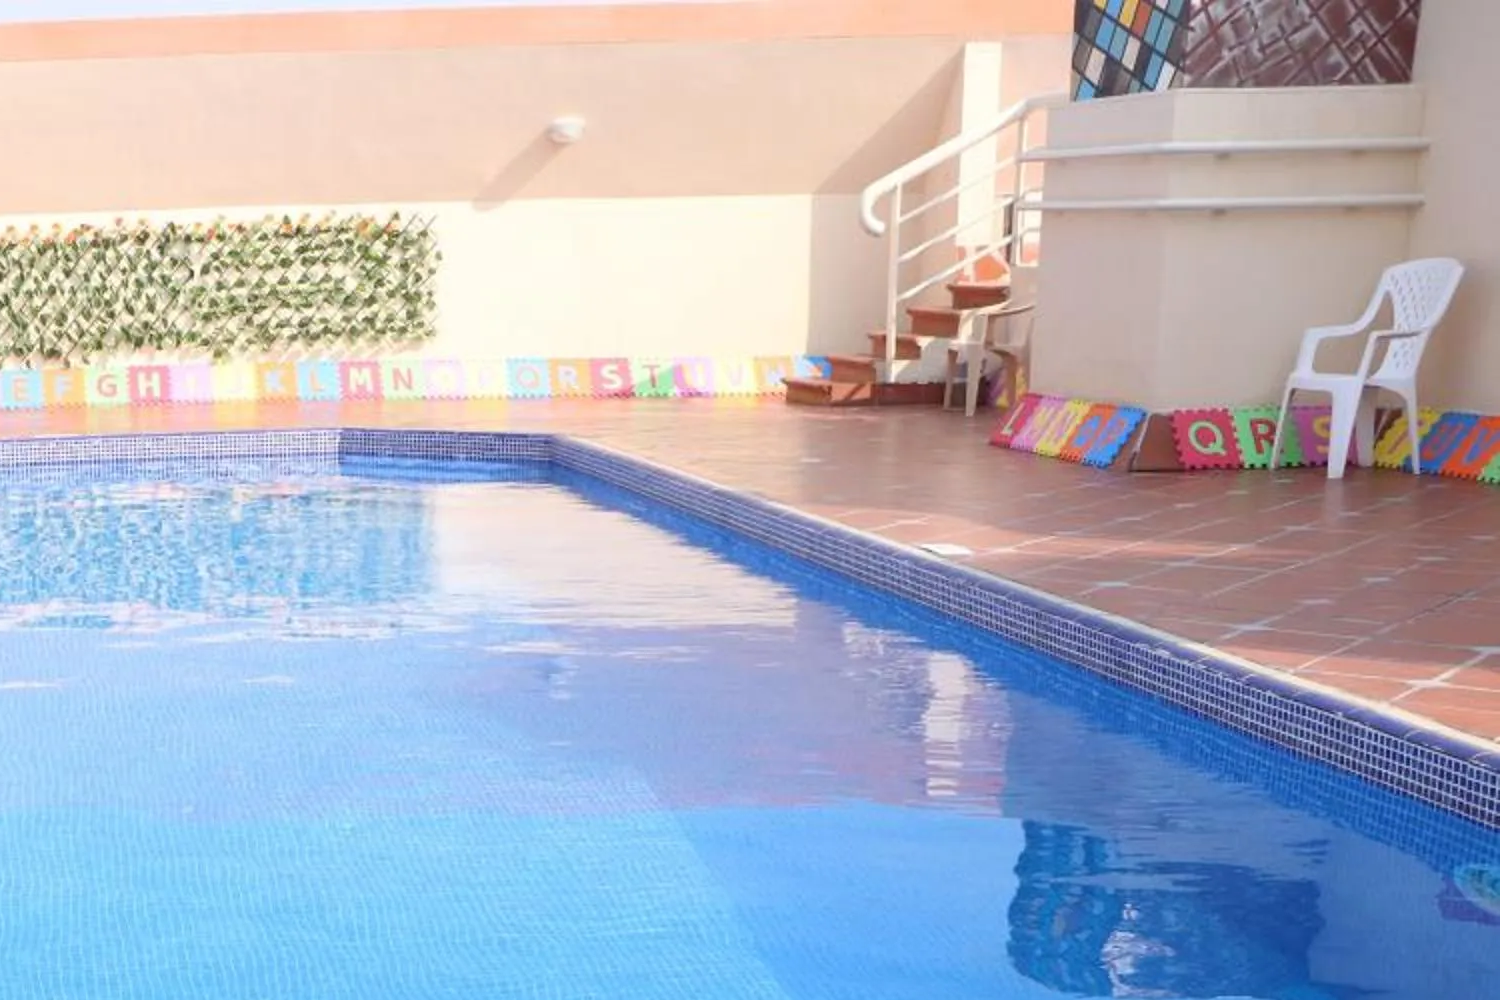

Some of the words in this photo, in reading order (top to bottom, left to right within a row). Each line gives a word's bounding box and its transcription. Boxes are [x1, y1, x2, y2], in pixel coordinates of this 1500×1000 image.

[97, 373, 118, 398] G
[137, 372, 160, 399] H
[349, 367, 373, 393] M
[392, 367, 414, 391] N
[600, 363, 623, 389] S
[642, 364, 660, 388] T
[1188, 421, 1227, 455] Q
